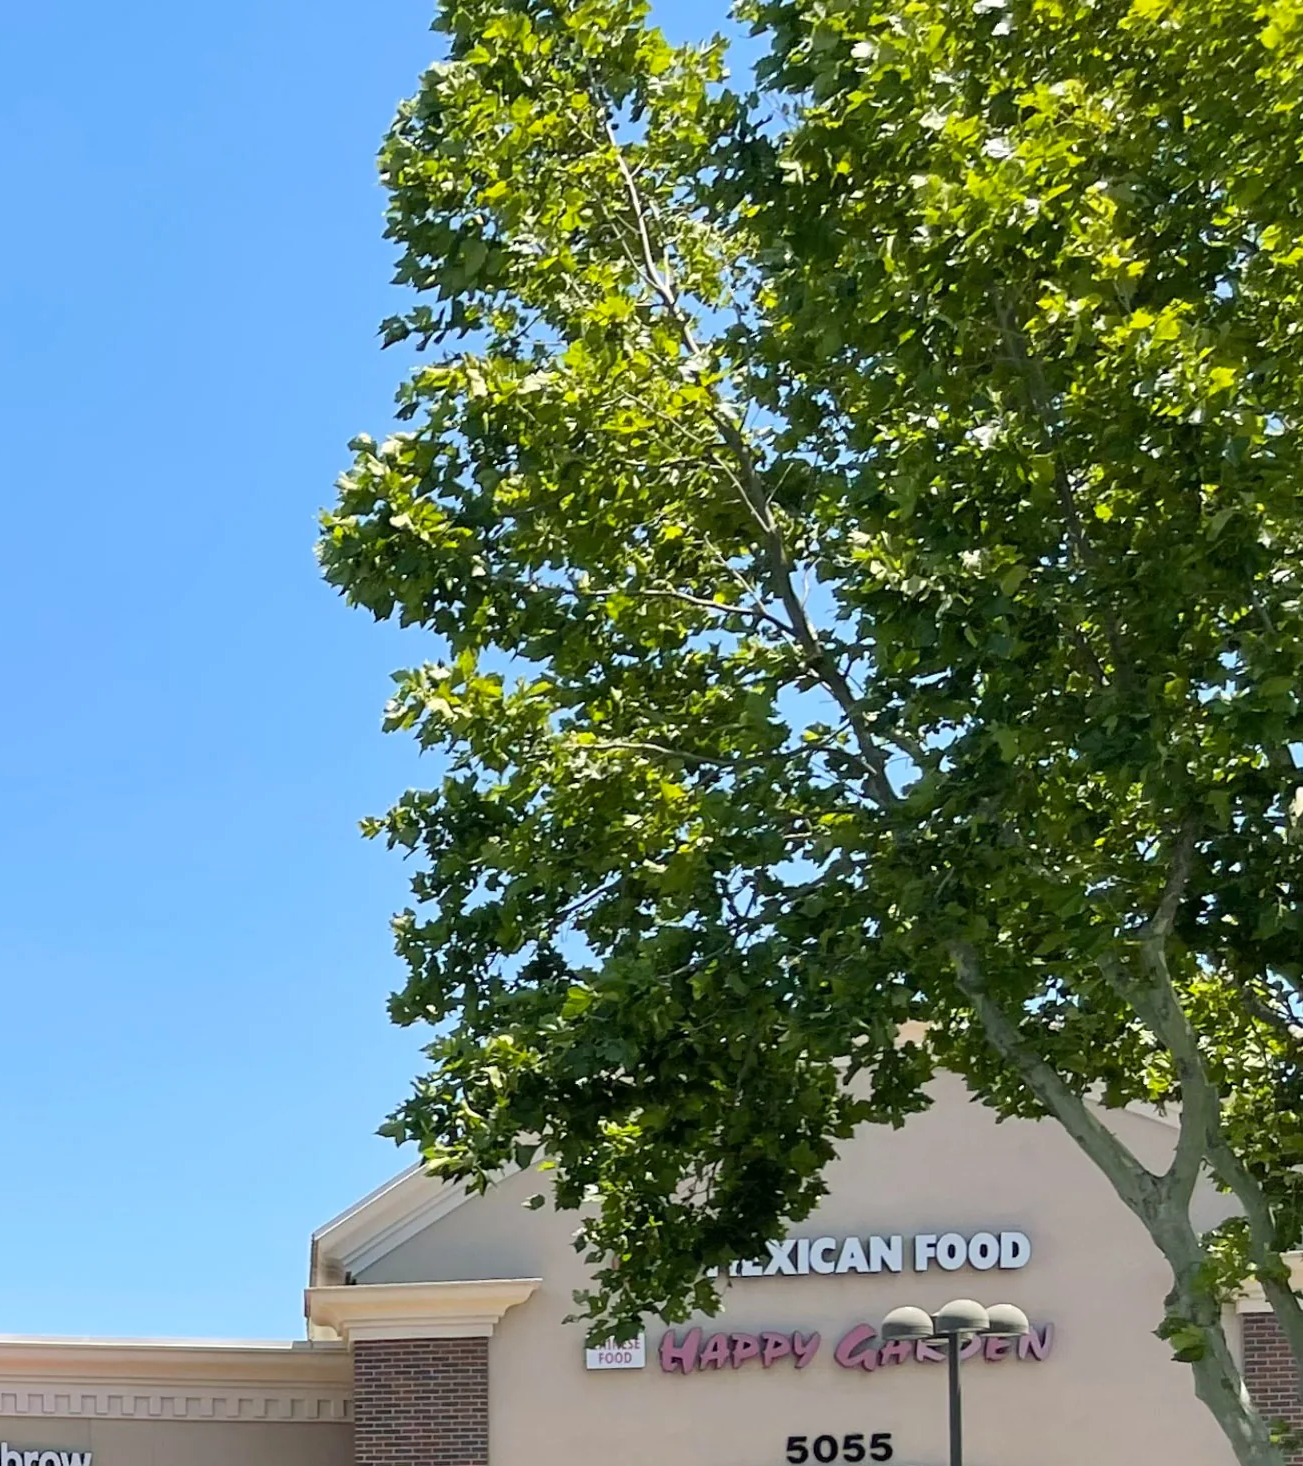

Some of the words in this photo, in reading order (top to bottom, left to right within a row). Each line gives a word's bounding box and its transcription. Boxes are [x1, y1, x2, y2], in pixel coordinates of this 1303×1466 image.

[914, 1230, 1032, 1273] FOOD
[598, 1351, 633, 1365] FOOD
[658, 1327, 822, 1375] HAPPY
[785, 1432, 894, 1465] 5055
